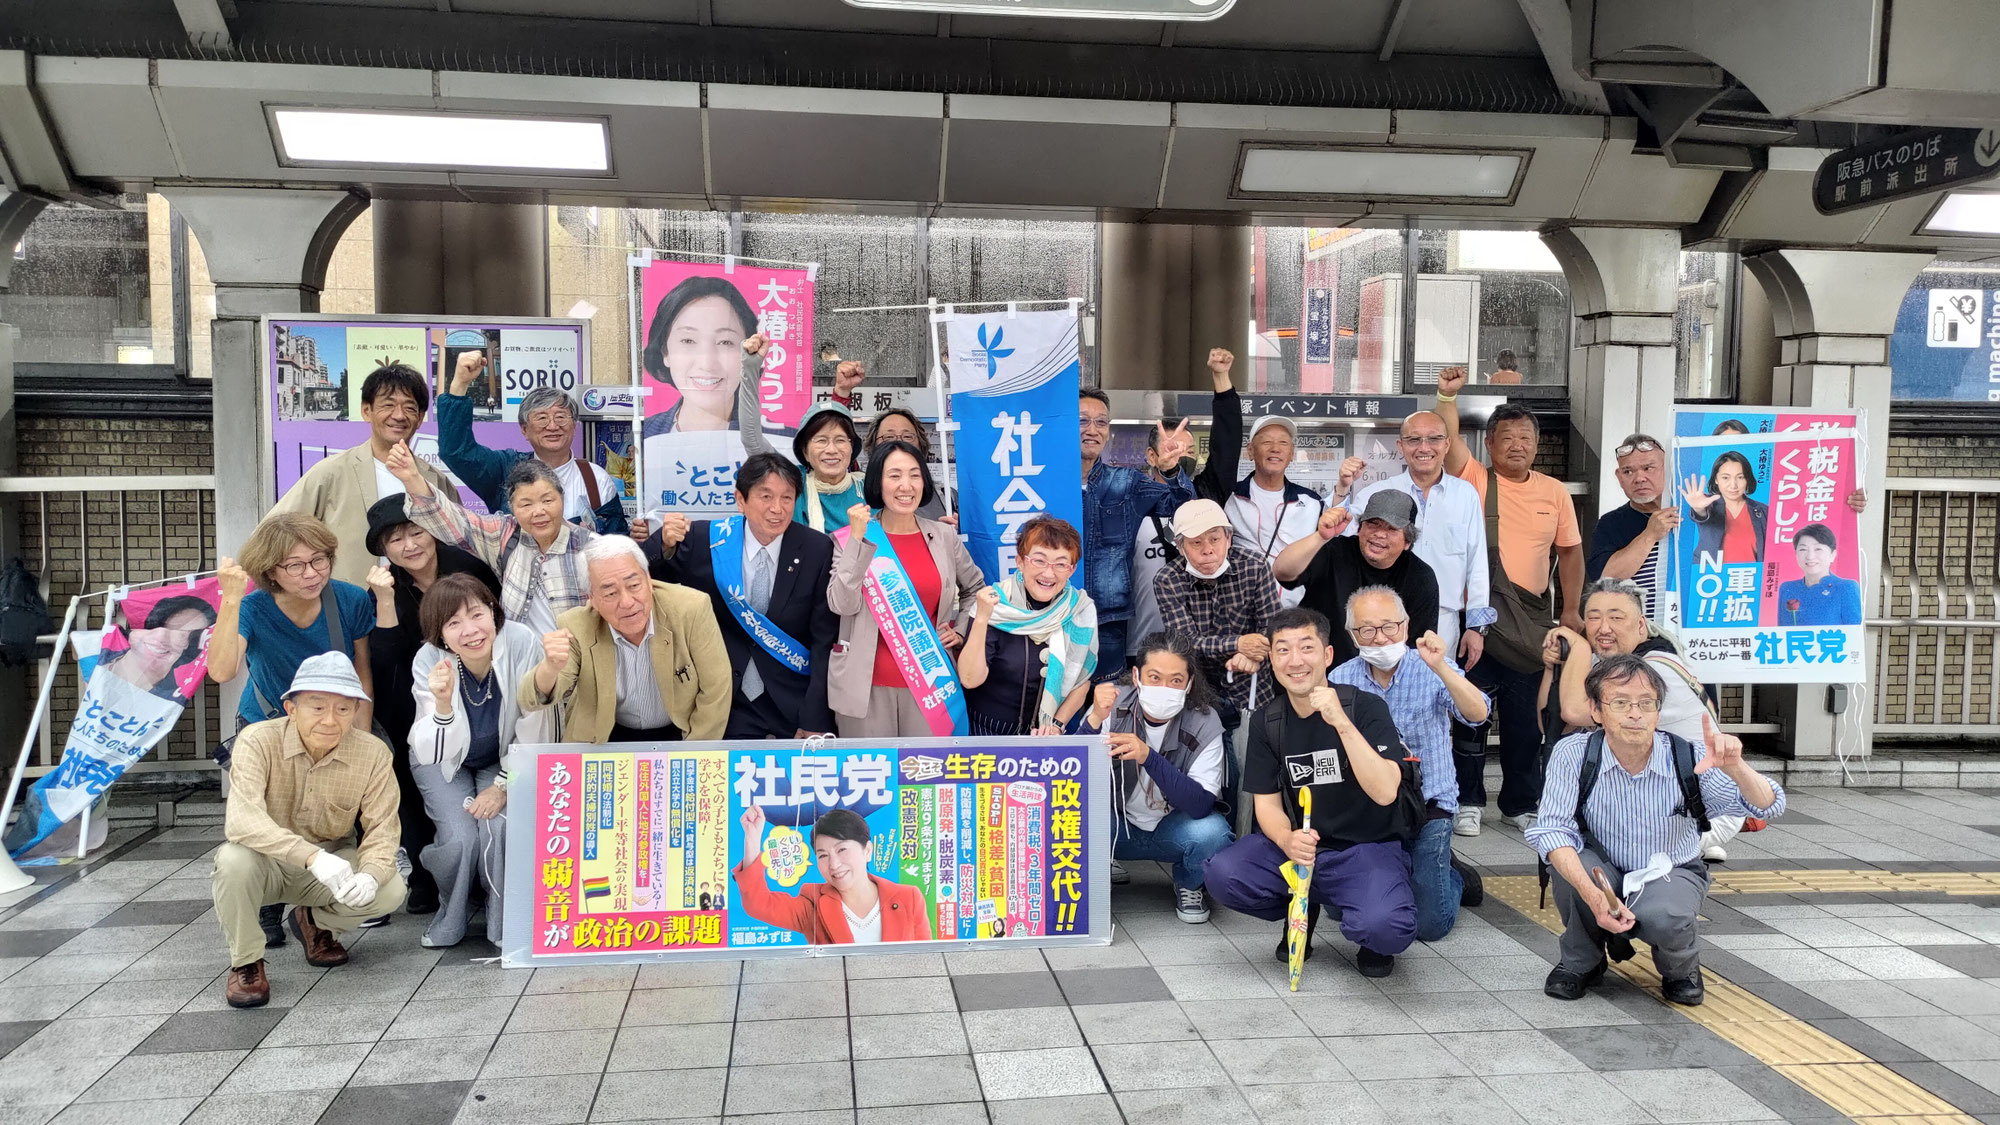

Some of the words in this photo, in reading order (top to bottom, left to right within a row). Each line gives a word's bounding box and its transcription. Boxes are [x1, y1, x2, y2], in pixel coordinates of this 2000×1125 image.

[1834, 156, 1959, 203] 駅前派出所
[1836, 134, 1943, 182] 阪急バスのりば
[505, 368, 575, 392] SORIO
[757, 277, 788, 429] 大椿ゆうこ
[1238, 400, 1380, 416] 塚イベント情報
[1774, 448, 1802, 544] くらしに
[1805, 445, 1840, 521] 税金は
[1696, 549, 1724, 623] NO!!
[1722, 565, 1757, 623] 軍拡
[862, 571, 921, 689] 働者の使い捨てを許さない!
[878, 569, 944, 675] 参議院議員
[1688, 636, 1751, 649] がんこに平和
[1754, 629, 1848, 664] 社民党
[1688, 650, 1752, 662] くらしが一番
[921, 679, 957, 710] 社民党
[733, 753, 894, 808] 社民党
[1315, 757, 1335, 768] NEW
[1315, 767, 1337, 777] ERA
[601, 762, 613, 827] 同性婚の法制化
[698, 758, 712, 836] 学びを保障!
[712, 758, 726, 882] すべての子どもたちに
[900, 789, 919, 860] 改憲反対
[990, 786, 1004, 826] STOP!!
[541, 761, 574, 948] あなたの弱音が
[613, 759, 630, 911] ジェンダー平等社会の実現
[652, 759, 665, 910] 私たちはすでに一緒に生きている!
[767, 839, 784, 880] 最優先!
[779, 837, 796, 877] くらしが
[789, 835, 803, 865] いのち
[920, 788, 934, 896] 憲法9条守ります!
[939, 788, 955, 885] 脱原発・脱炭素
[989, 829, 1005, 898] 格差・貧困
[1050, 778, 1083, 932] 政権交代!!
[1026, 806, 1043, 934] 消費税、3年間ゼロ!
[572, 914, 723, 949] 政治の課題
[731, 930, 792, 946] 福島みずほ
